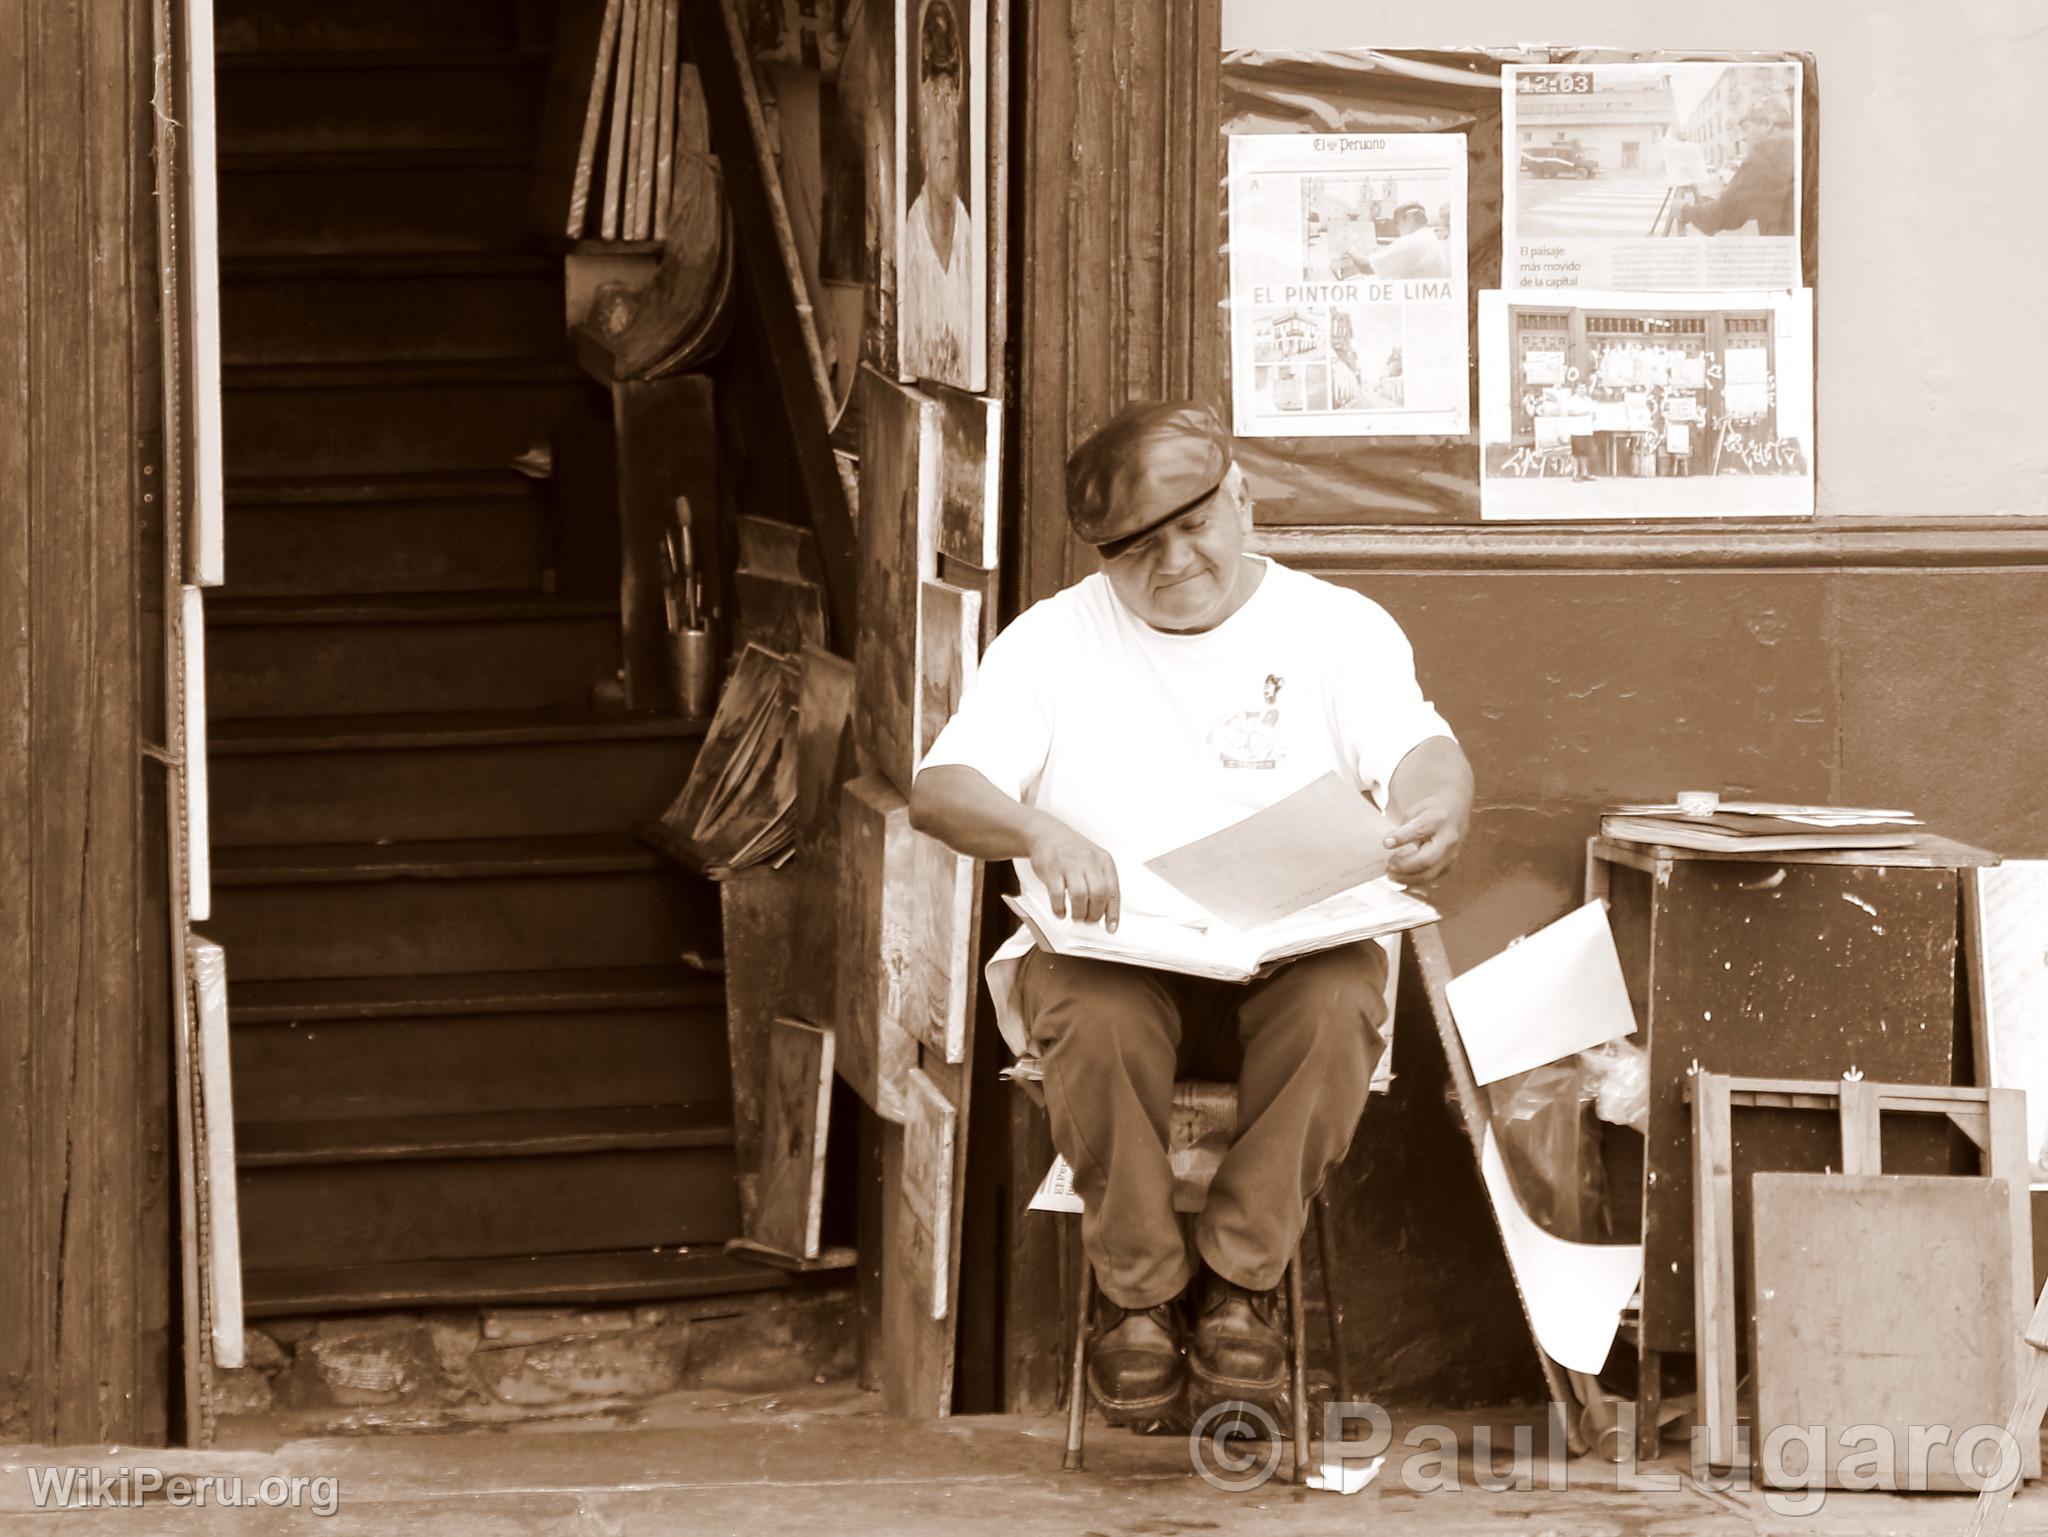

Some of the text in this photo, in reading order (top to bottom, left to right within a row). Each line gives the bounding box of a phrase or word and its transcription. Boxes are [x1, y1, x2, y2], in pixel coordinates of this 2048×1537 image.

[1519, 75, 1589, 94] 12:03
[1313, 138, 1386, 153] El Peruano
[1520, 246, 1566, 259] El paisaje
[1519, 261, 1581, 272] más movido
[1519, 276, 1578, 289] de la capital
[1253, 282, 1452, 304] EL PINTOR DE LIMA
